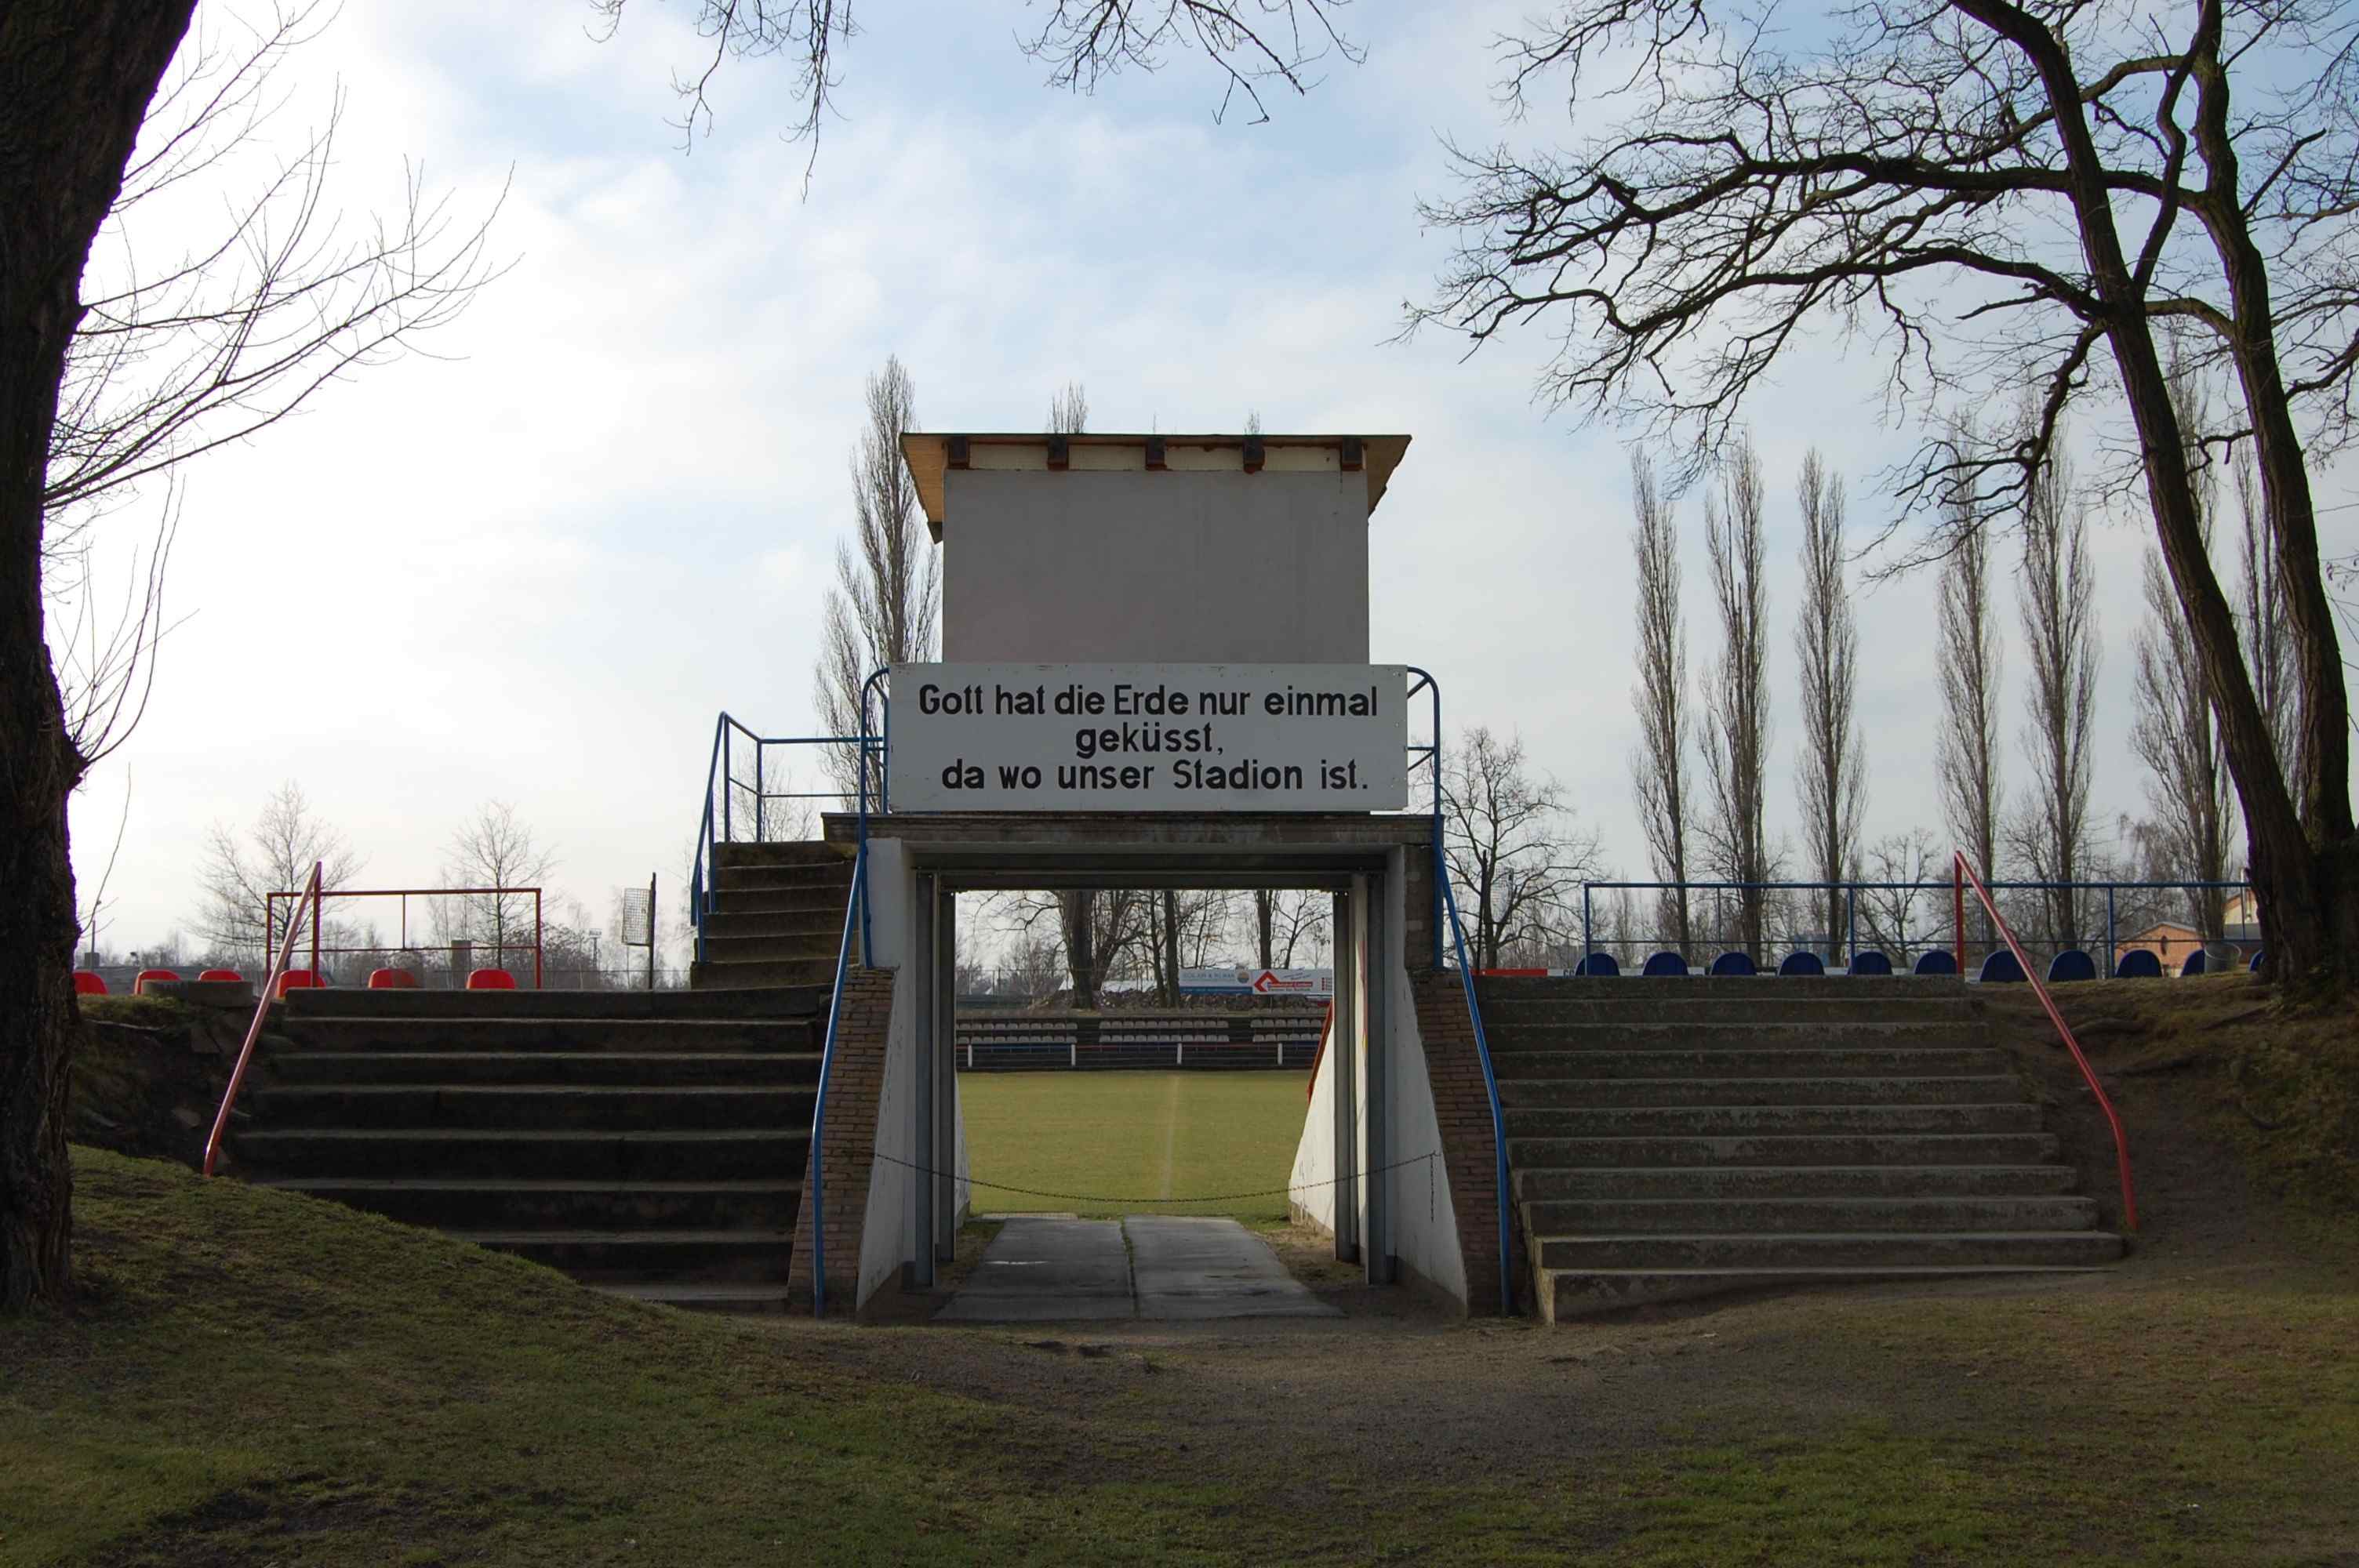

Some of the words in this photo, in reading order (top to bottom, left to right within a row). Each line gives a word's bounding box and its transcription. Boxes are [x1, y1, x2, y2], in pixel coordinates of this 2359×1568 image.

[918, 683, 984, 716] Gott
[994, 684, 1046, 716] hat
[1053, 683, 1106, 716] die
[1114, 684, 1190, 716] Erde
[1199, 691, 1252, 716] nur
[1263, 684, 1377, 717] einmal
[1075, 720, 1223, 760] geküsst,
[941, 757, 985, 790] da
[998, 764, 1042, 790] wo
[1057, 764, 1155, 790] unser
[1172, 758, 1303, 790] Stadion
[1320, 758, 1369, 790] ist.
